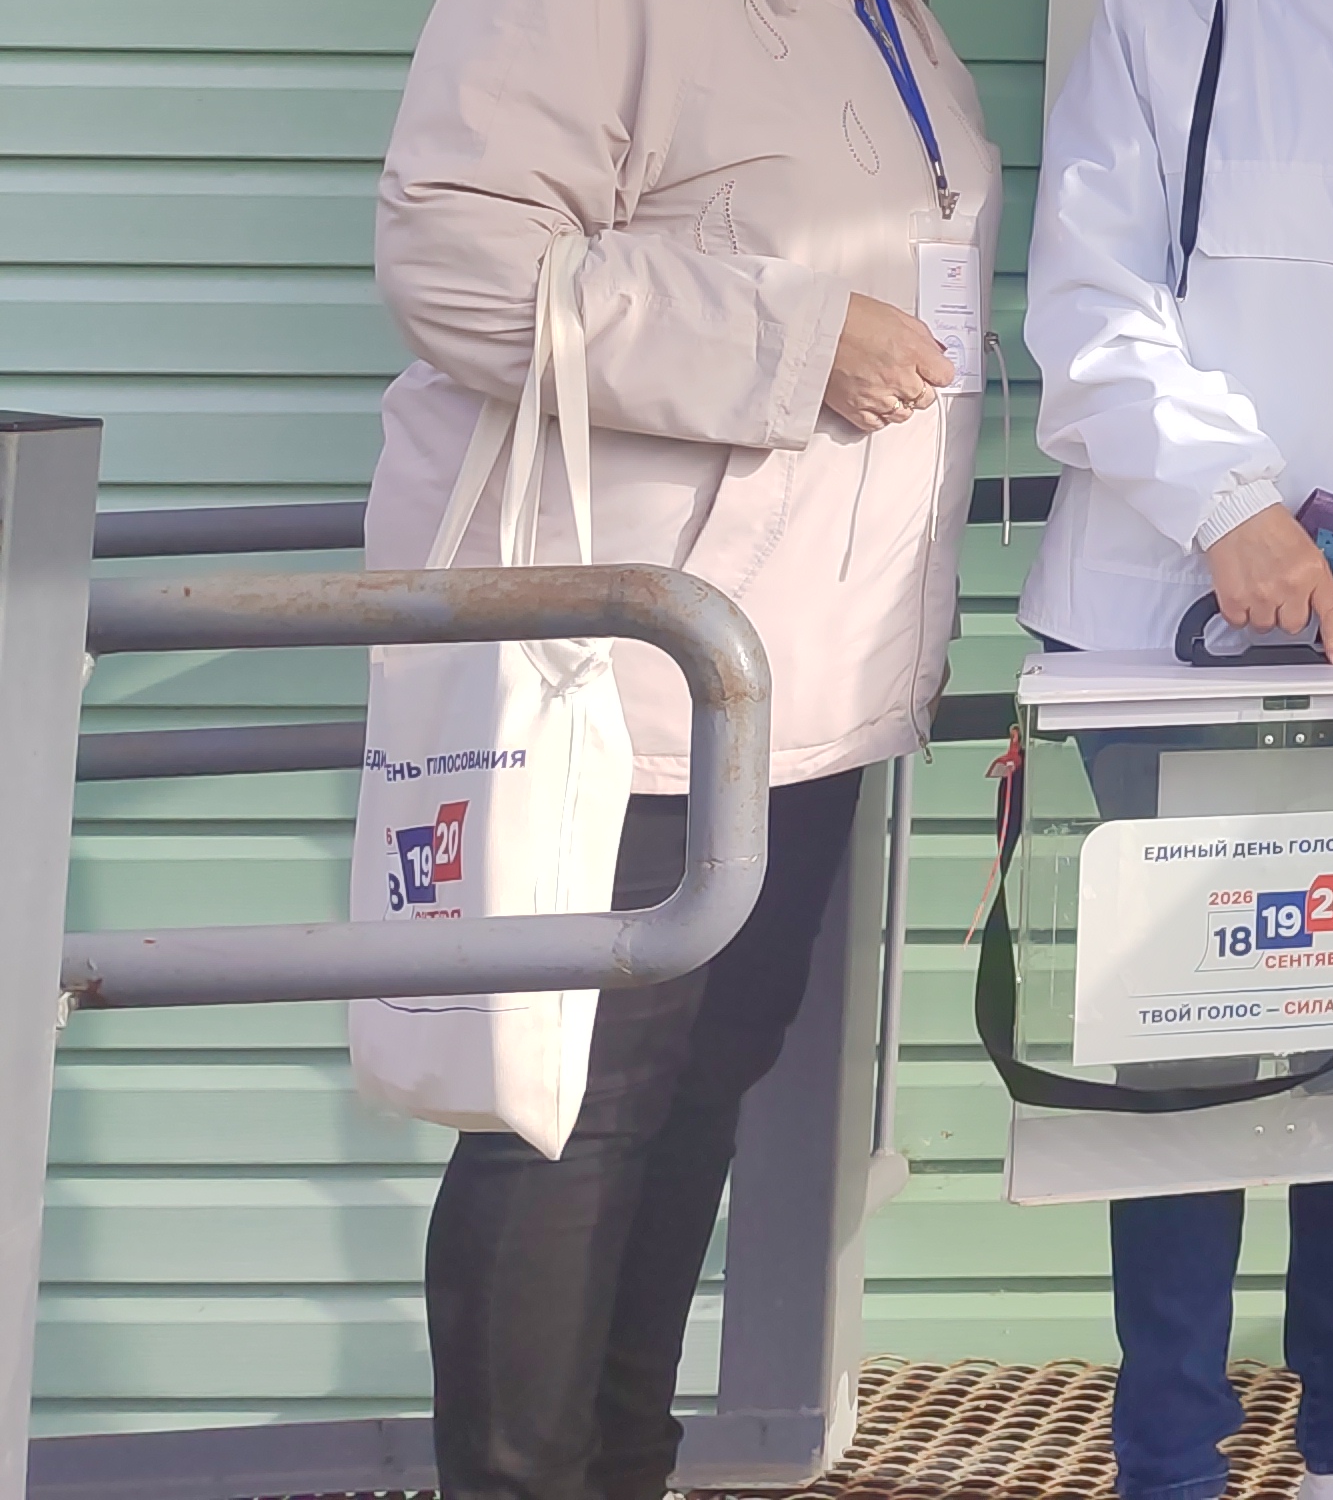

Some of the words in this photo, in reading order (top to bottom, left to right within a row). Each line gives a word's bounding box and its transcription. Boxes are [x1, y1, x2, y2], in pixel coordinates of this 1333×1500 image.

[386, 762, 422, 782] ЕНЬ
[426, 749, 526, 776] ГЛОСОВАНИЯ
[406, 845, 433, 887] 19
[435, 821, 459, 865] 20
[1144, 839, 1228, 862] ЕДИНЫЙ
[1233, 841, 1284, 859] ДЕНЬ
[1208, 891, 1253, 906] 2026
[1213, 925, 1252, 958] 18
[1261, 905, 1302, 939] 19
[1138, 1003, 1191, 1024] ТВОЙ
[1197, 1003, 1262, 1021] ГОЛОС
